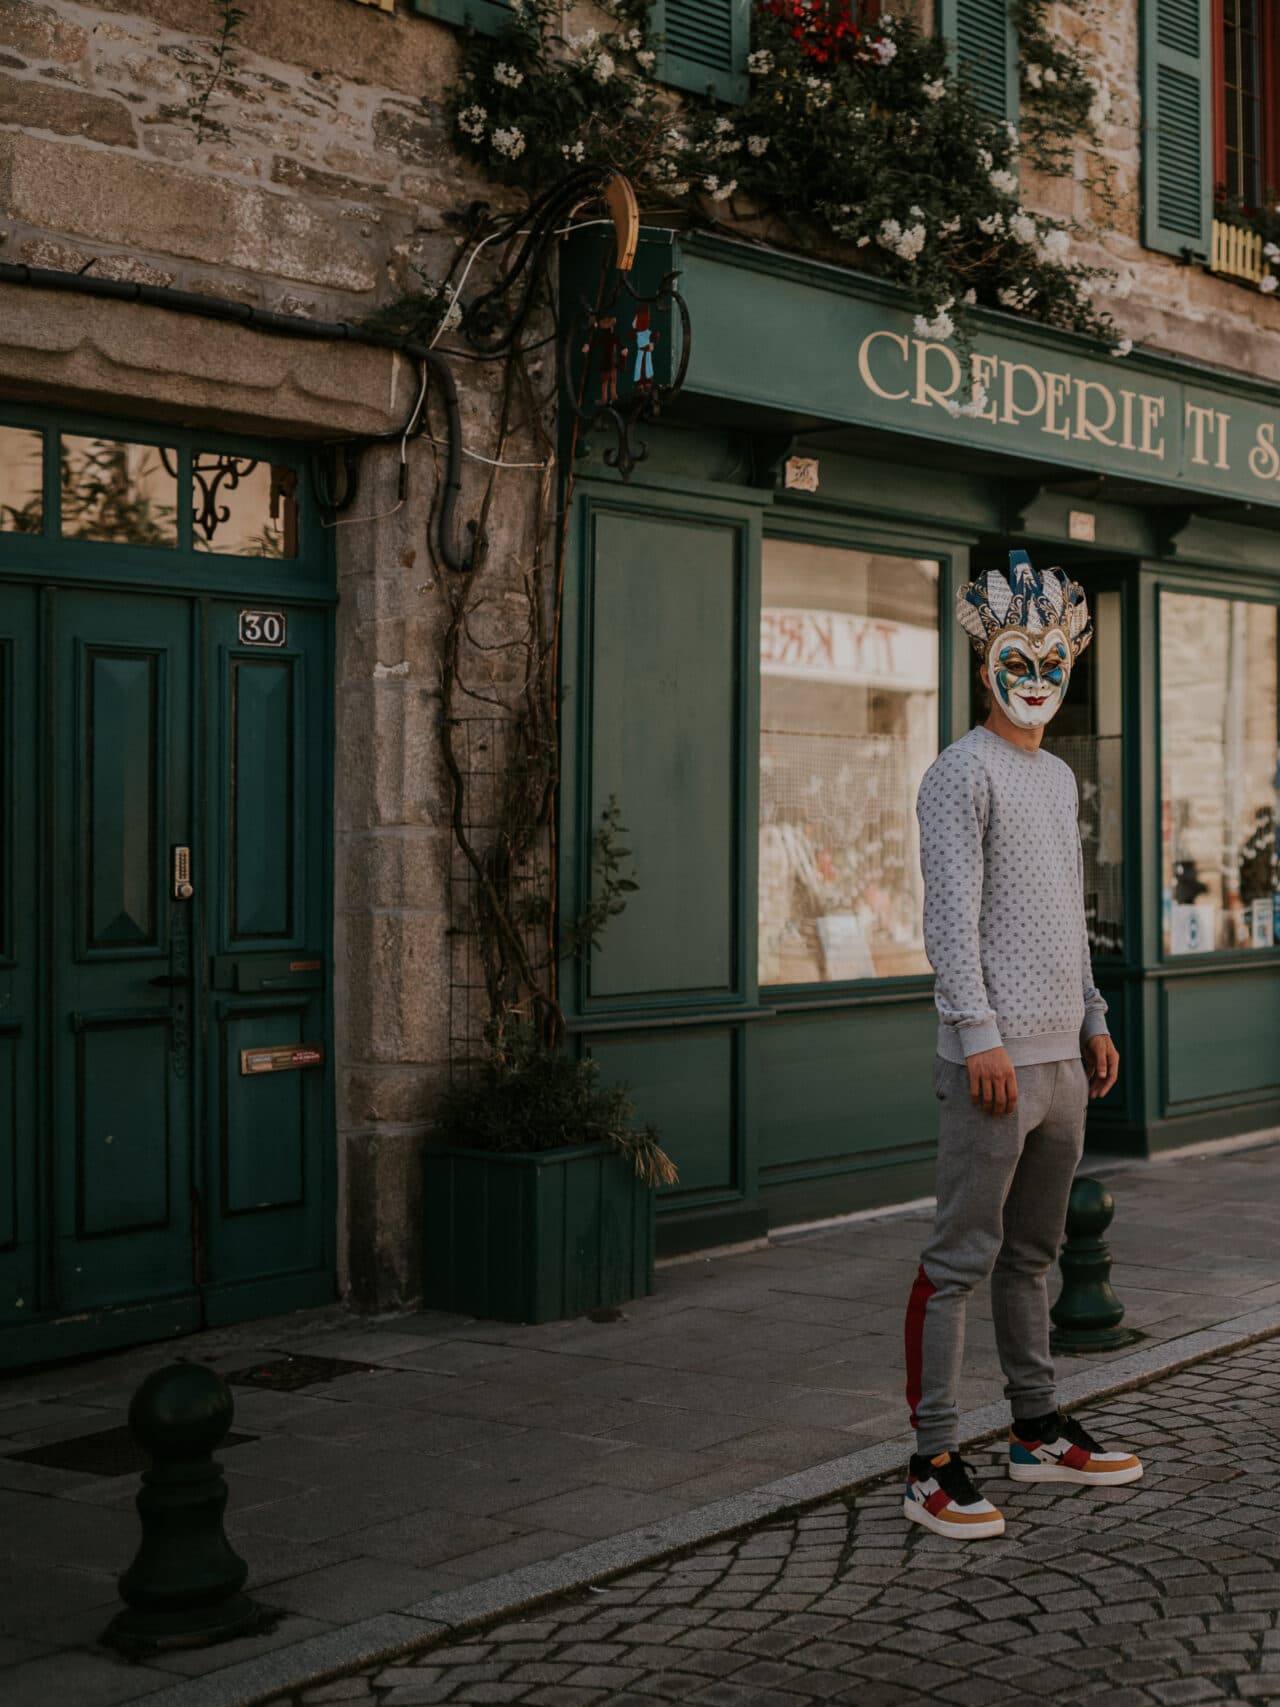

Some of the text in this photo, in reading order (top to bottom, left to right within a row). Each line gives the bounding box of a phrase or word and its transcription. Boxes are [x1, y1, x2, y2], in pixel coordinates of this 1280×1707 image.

[858, 330, 1165, 459] CREPERIE
[1185, 401, 1231, 469] TI
[245, 614, 280, 642] 30
